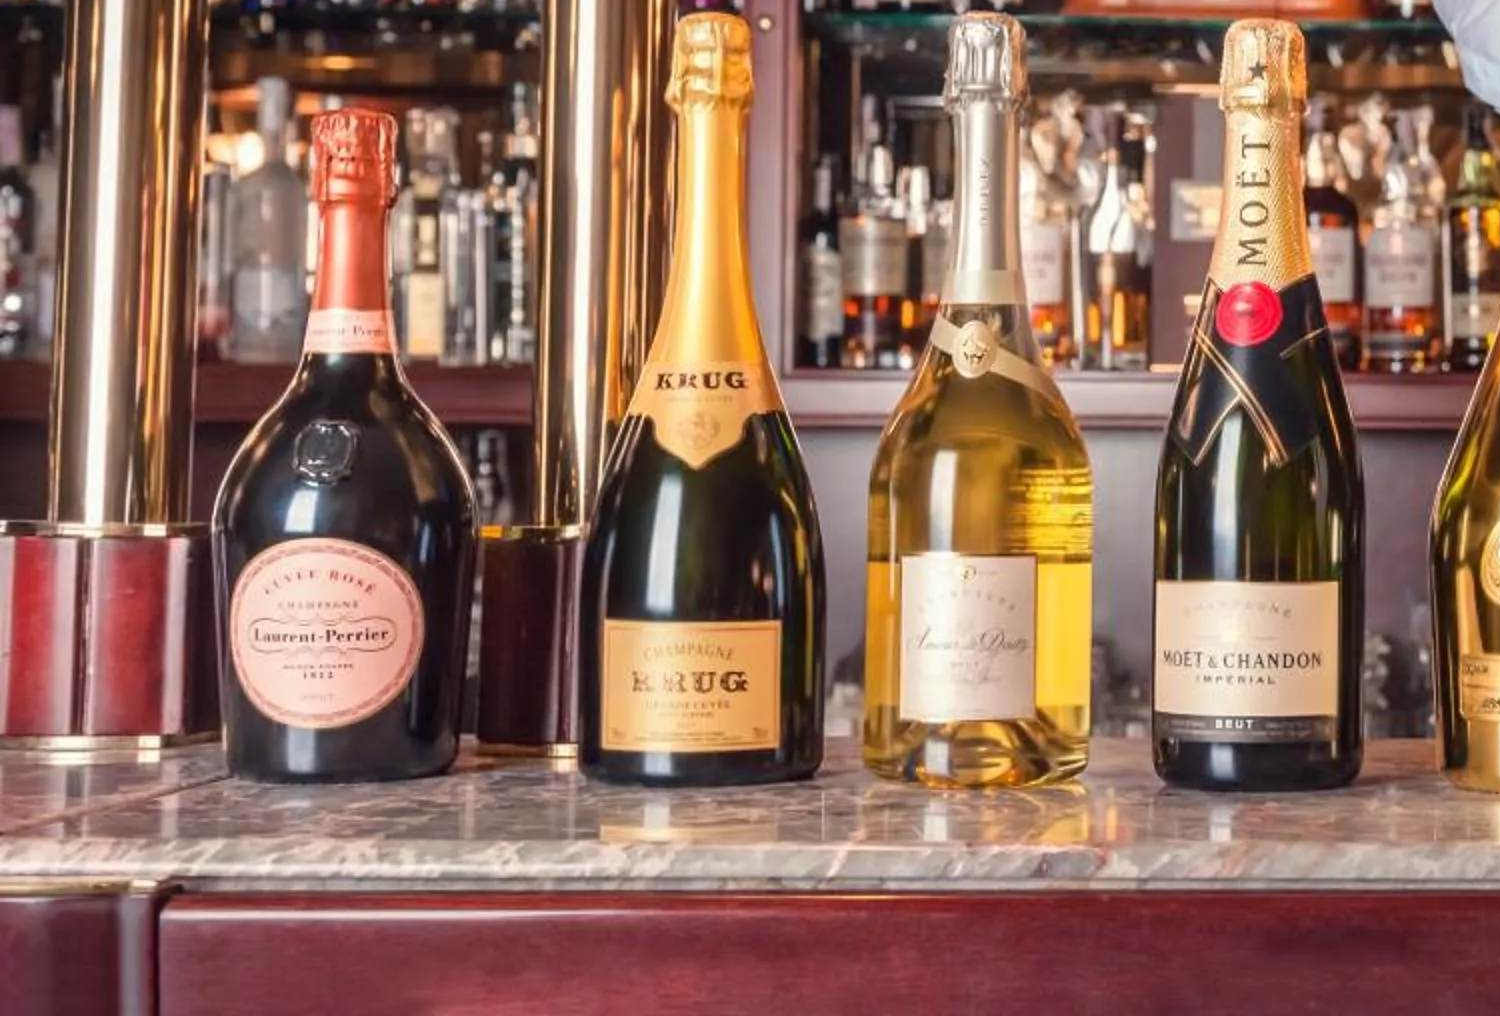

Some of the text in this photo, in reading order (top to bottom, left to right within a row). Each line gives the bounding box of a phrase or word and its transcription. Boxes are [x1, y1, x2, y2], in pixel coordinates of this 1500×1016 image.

[1236, 135, 1270, 266] MOËT
[654, 371, 747, 390] KRUG
[254, 627, 390, 644] Laurent-Perrier
[1207, 654, 1219, 669] &
[1223, 651, 1322, 669] CHANDON
[631, 670, 749, 693] KRUG
[1215, 719, 1254, 729] BRUT
